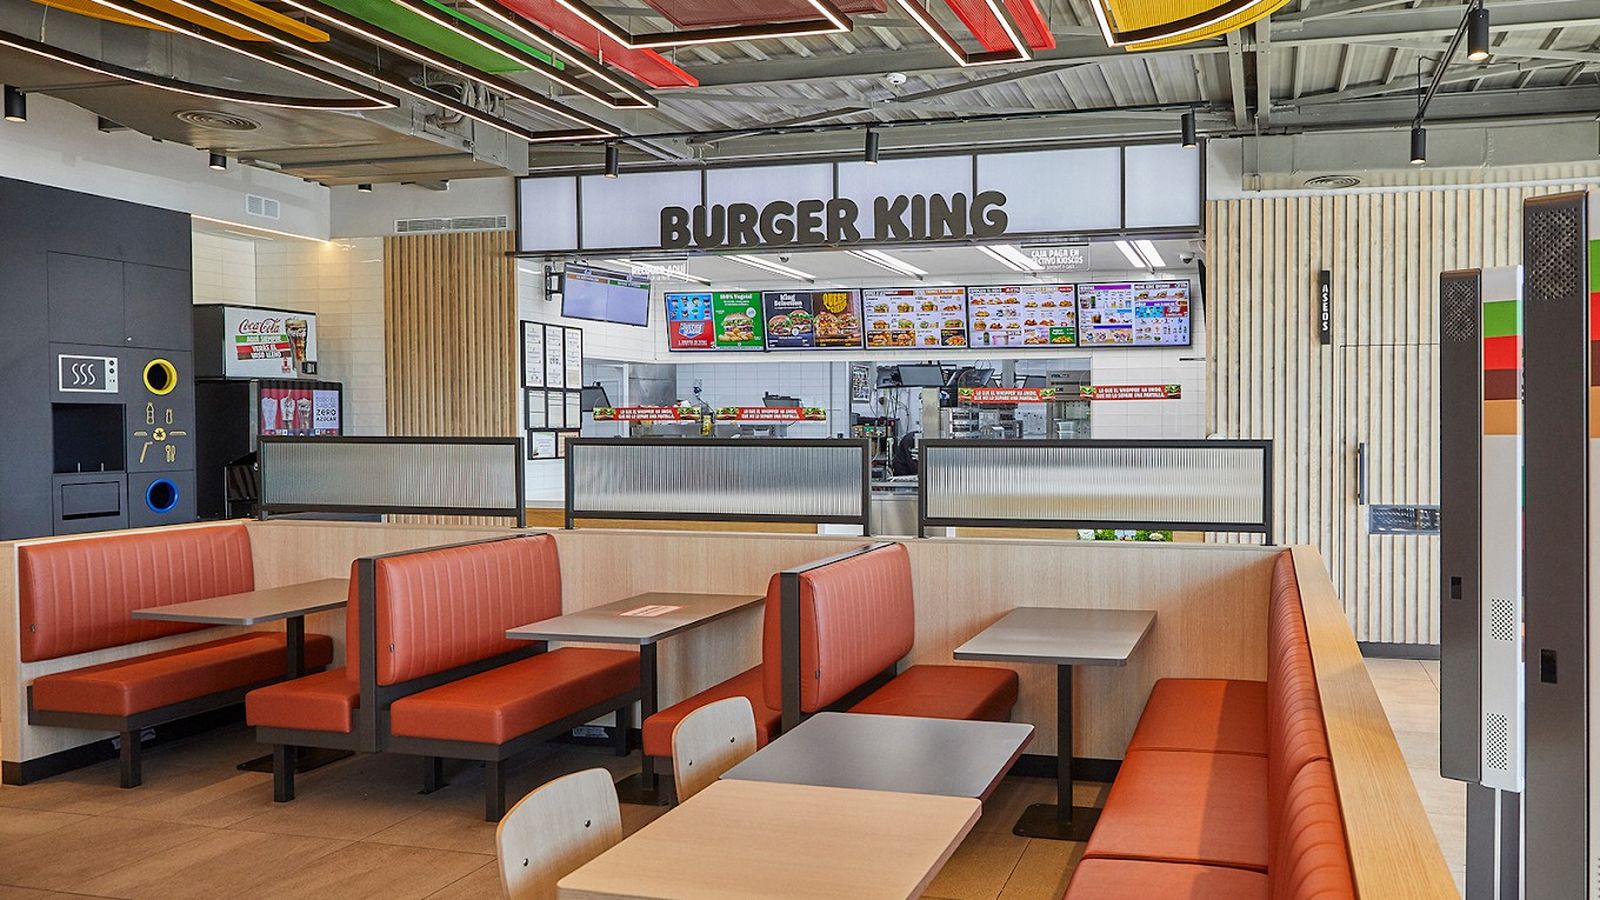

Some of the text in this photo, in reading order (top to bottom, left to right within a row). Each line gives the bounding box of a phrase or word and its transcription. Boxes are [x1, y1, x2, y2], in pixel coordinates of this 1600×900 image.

[660, 191, 1008, 249] BURGER KING
[239, 318, 282, 334] Coca-Cola
